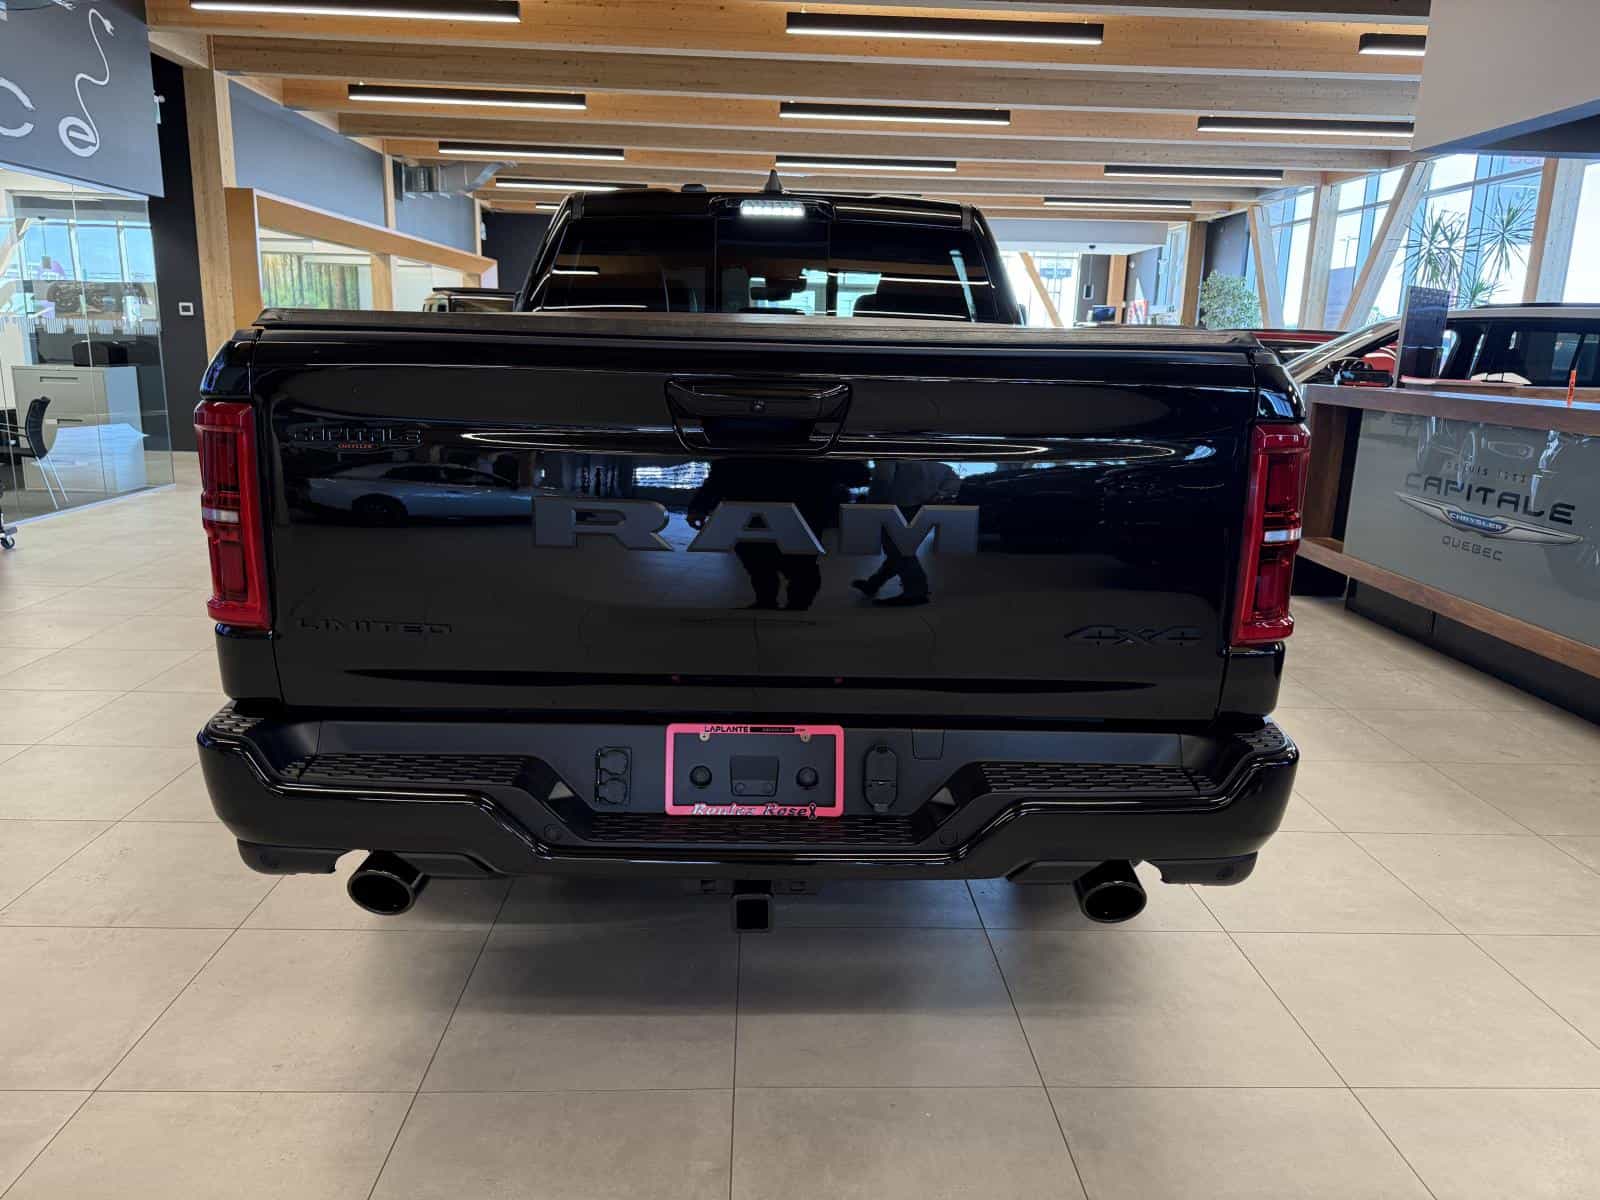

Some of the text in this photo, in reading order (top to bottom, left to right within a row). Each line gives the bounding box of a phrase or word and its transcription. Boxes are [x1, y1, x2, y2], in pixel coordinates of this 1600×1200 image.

[1405, 472, 1575, 525] CAPITALE
[534, 500, 980, 555] RAM
[296, 618, 452, 634] LIMITED
[763, 802, 808, 817] Rose
